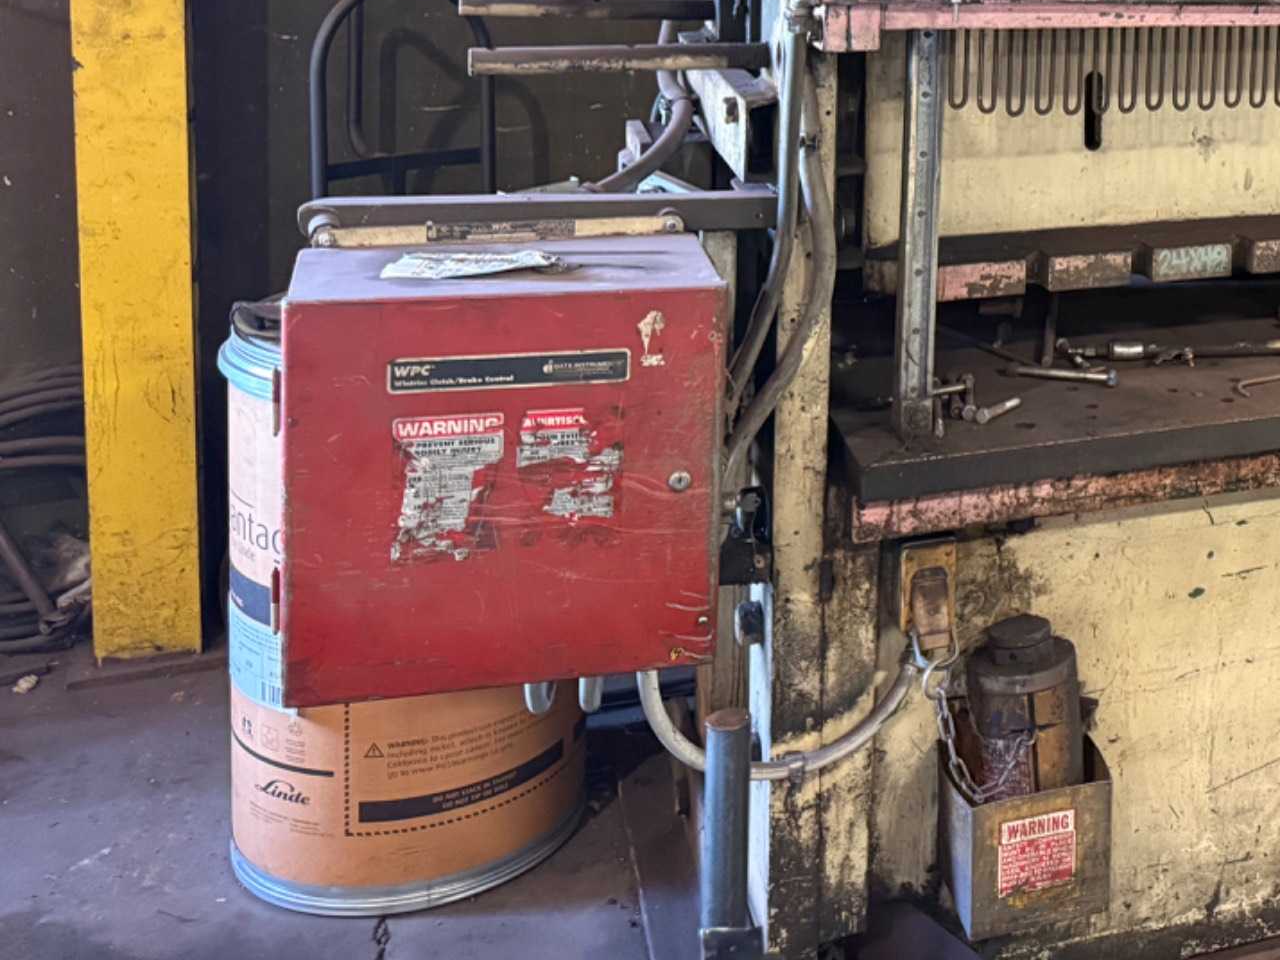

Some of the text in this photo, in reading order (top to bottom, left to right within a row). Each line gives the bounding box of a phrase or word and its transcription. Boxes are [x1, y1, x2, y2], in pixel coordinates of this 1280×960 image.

[394, 364, 430, 377] WPC
[397, 417, 500, 437] WARNING
[255, 779, 311, 806] Linde
[1007, 814, 1071, 840] WARNING
